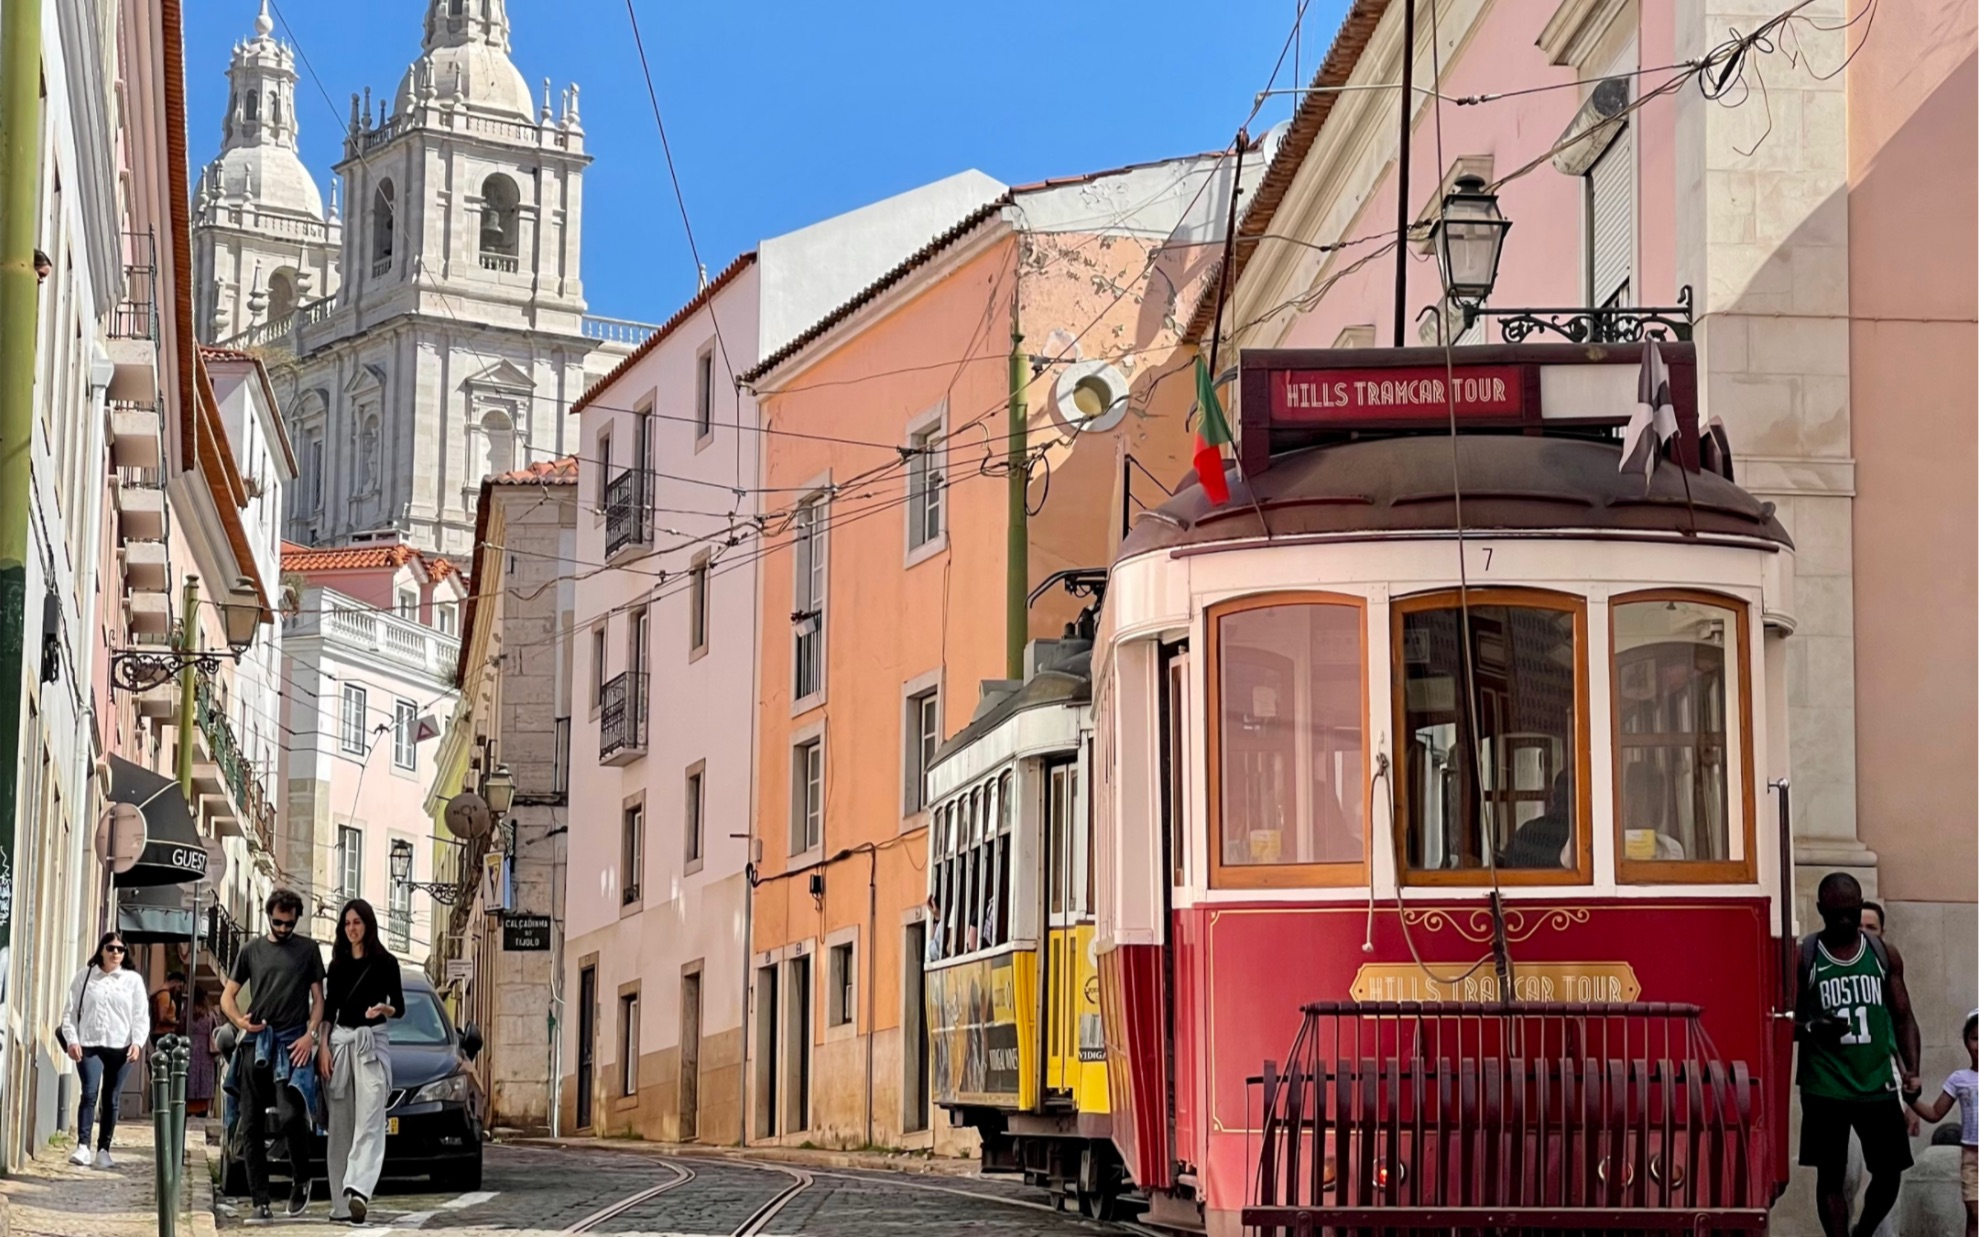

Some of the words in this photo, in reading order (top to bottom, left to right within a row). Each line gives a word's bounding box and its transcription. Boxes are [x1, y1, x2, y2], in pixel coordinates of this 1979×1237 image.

[1286, 382, 1349, 408] HILLS
[1353, 379, 1446, 406] TRAMCAR
[1451, 377, 1507, 403] TOUR
[1482, 547, 1493, 571] 7
[172, 848, 207, 870] GUEST
[505, 919, 548, 930] CALÇADINHA
[515, 937, 540, 947] TIJOLO
[1369, 976, 1441, 1002] HILLS
[1447, 975, 1555, 1003] TRACAR
[1562, 974, 1623, 1003] TOUR
[1819, 974, 1882, 1010] BOSTON
